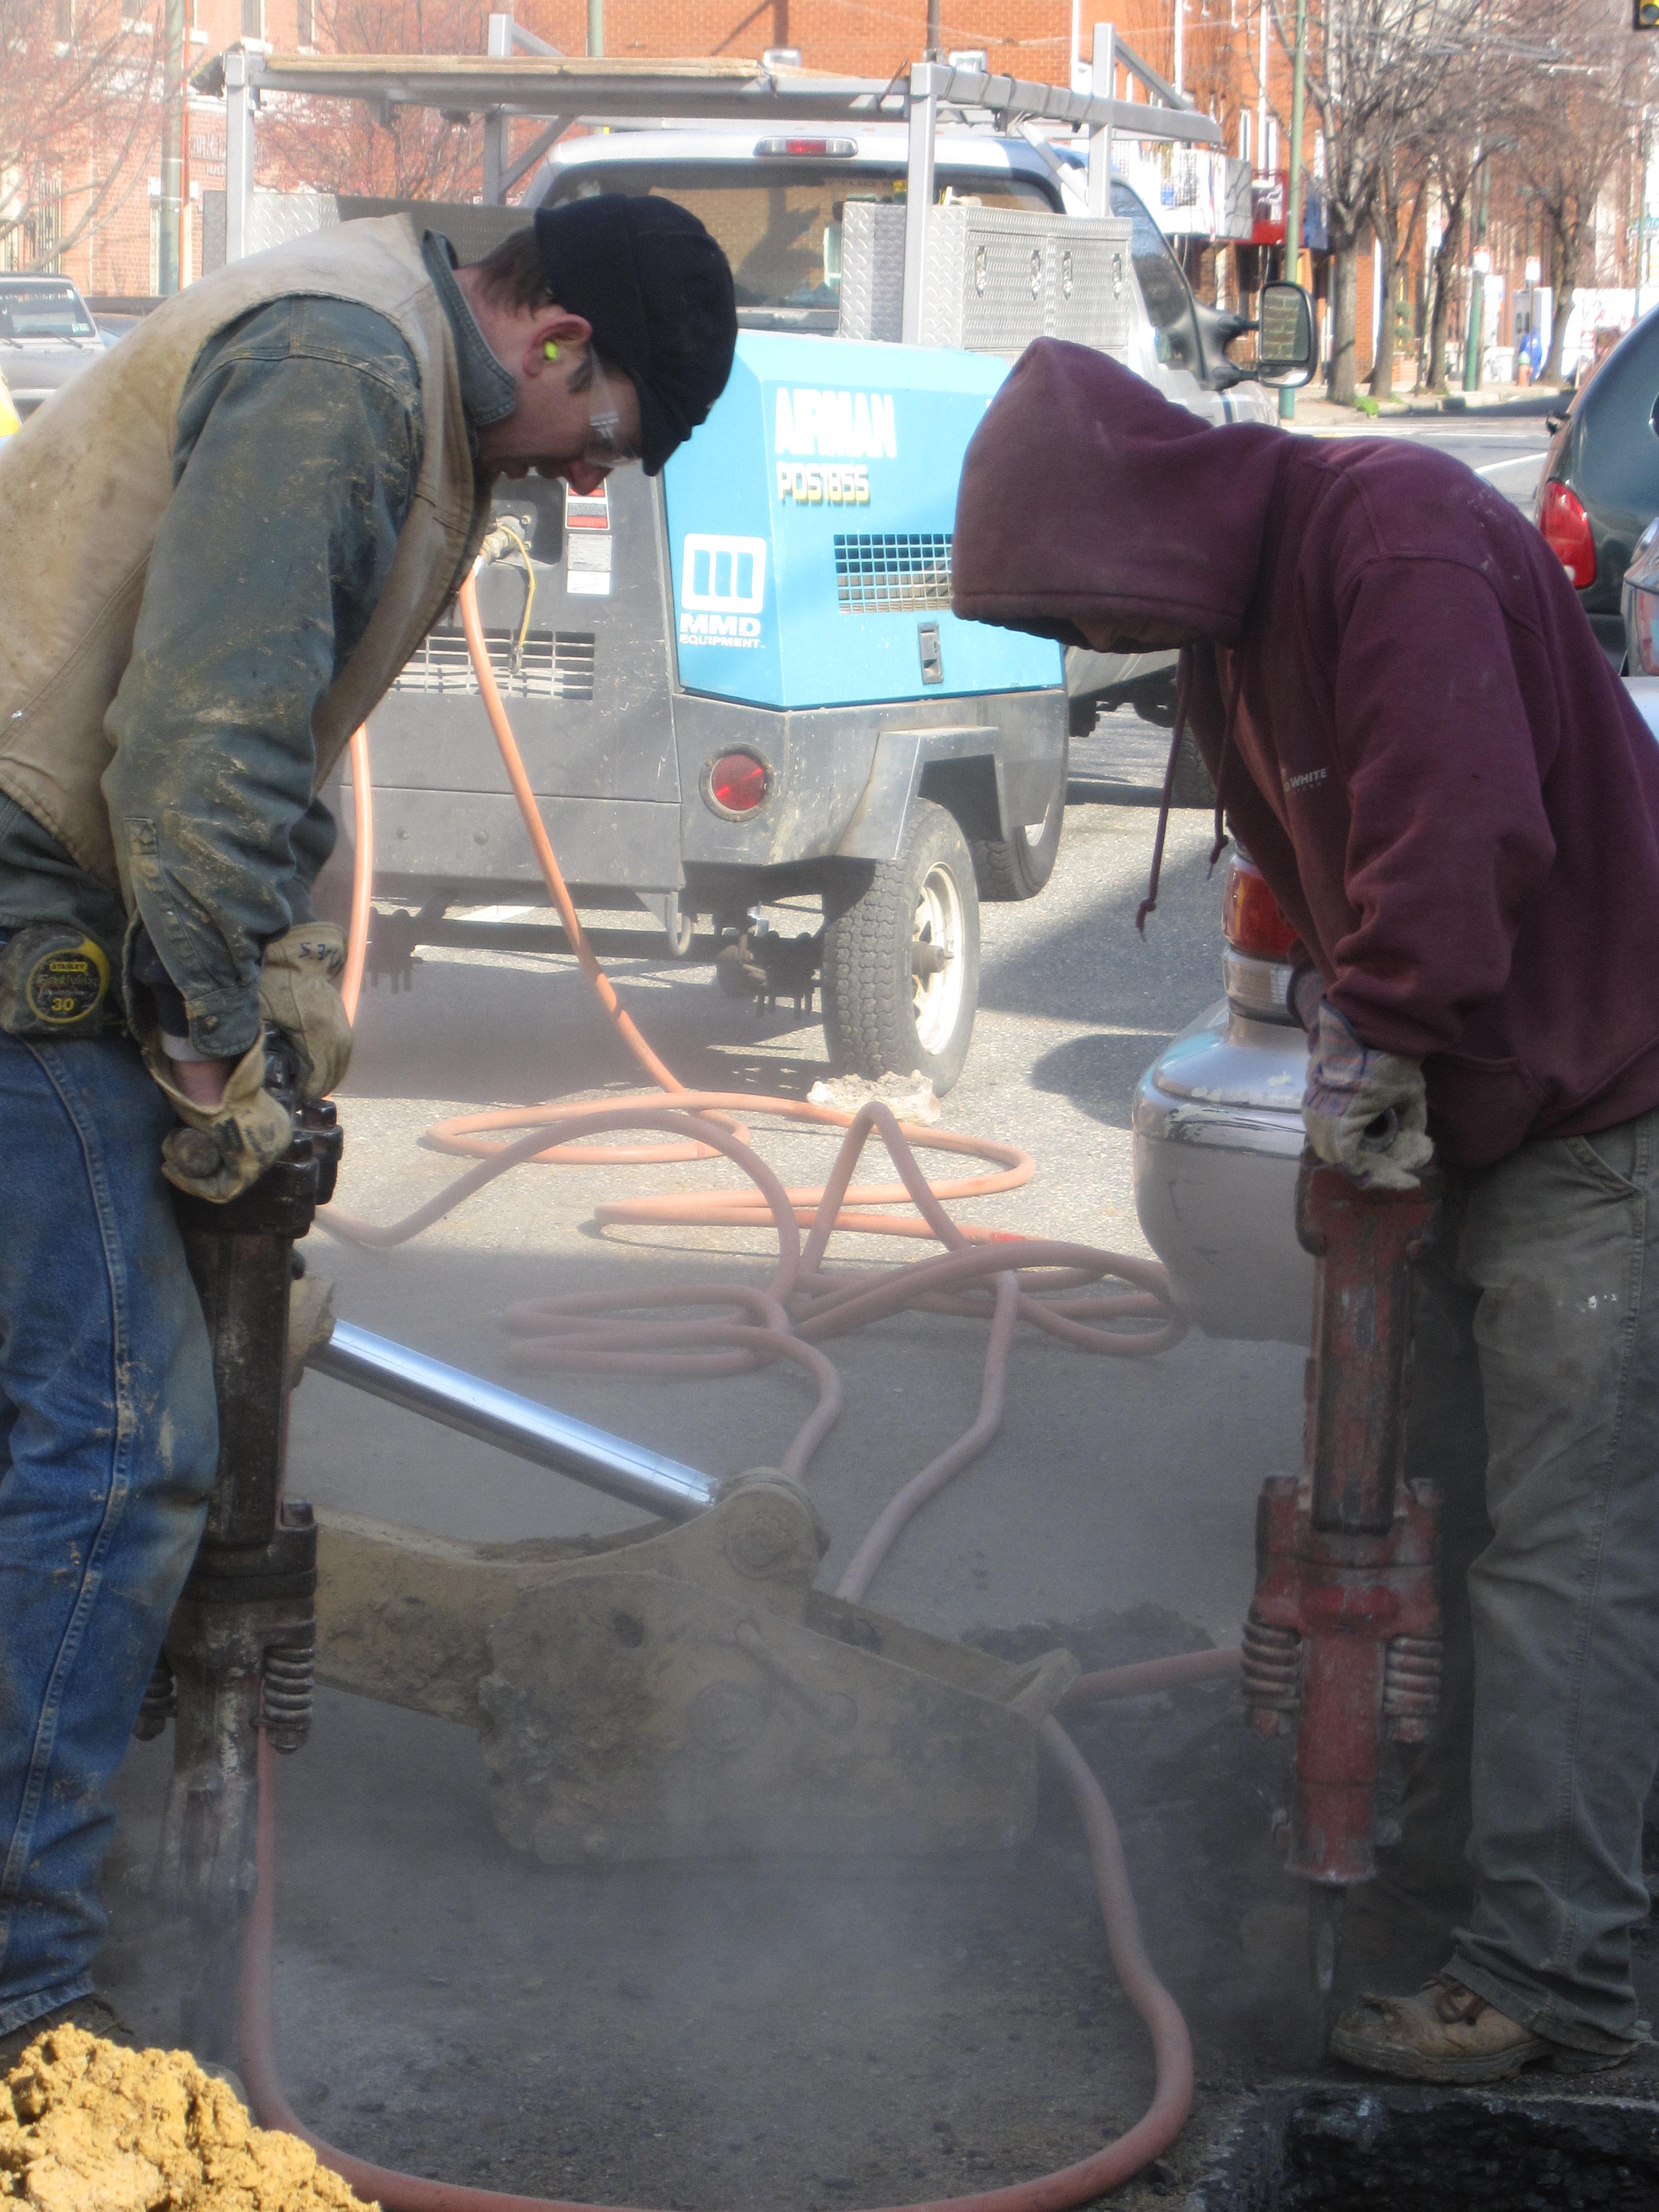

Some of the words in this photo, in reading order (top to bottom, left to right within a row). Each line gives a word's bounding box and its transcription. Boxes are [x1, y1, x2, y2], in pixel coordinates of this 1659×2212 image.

[680, 612, 761, 637] MMD
[679, 634, 761, 648] EQUIPMENT
[51, 997, 75, 1012] 30
